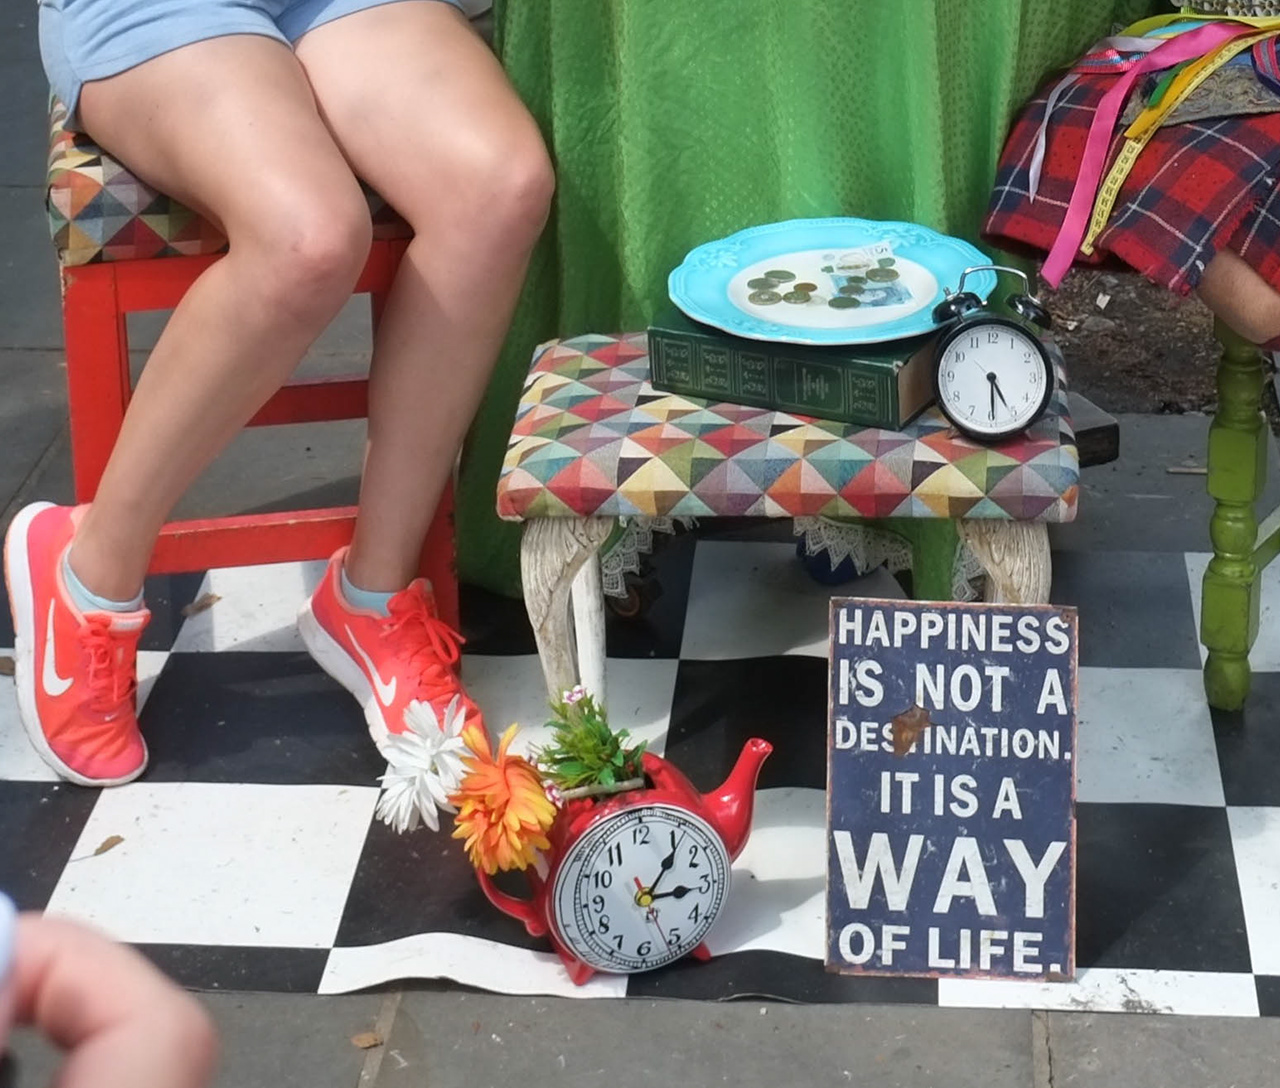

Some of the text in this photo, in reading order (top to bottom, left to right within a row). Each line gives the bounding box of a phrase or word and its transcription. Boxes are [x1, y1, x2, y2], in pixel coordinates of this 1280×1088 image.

[970, 337, 979, 349] 11
[987, 332, 999, 344] 12
[1010, 338, 1014, 349] 1
[954, 352, 965, 363] 10
[1024, 353, 1031, 363] 2
[947, 371, 955, 382] 9
[1029, 373, 1036, 383] 3
[953, 391, 960, 402] 8
[1023, 392, 1030, 403] 4
[969, 405, 976, 417] 7
[1010, 406, 1017, 417] 5
[838, 608, 1070, 655] HAPPINESS
[838, 658, 1068, 715] IS NOT A
[835, 720, 1072, 760] DESINATION.
[880, 771, 1023, 820] IT IS A
[633, 825, 651, 845] 12
[607, 842, 623, 866] 11
[688, 845, 700, 868] 2
[593, 870, 612, 888] 10
[833, 830, 1068, 919] WAY
[699, 874, 710, 894] 3
[592, 895, 605, 913] 9
[688, 902, 703, 924] 4
[598, 915, 610, 934] 8
[612, 935, 624, 950] 7
[669, 928, 681, 946] 5
[636, 941, 651, 956] 6
[838, 922, 1062, 973] OF LIFE.
